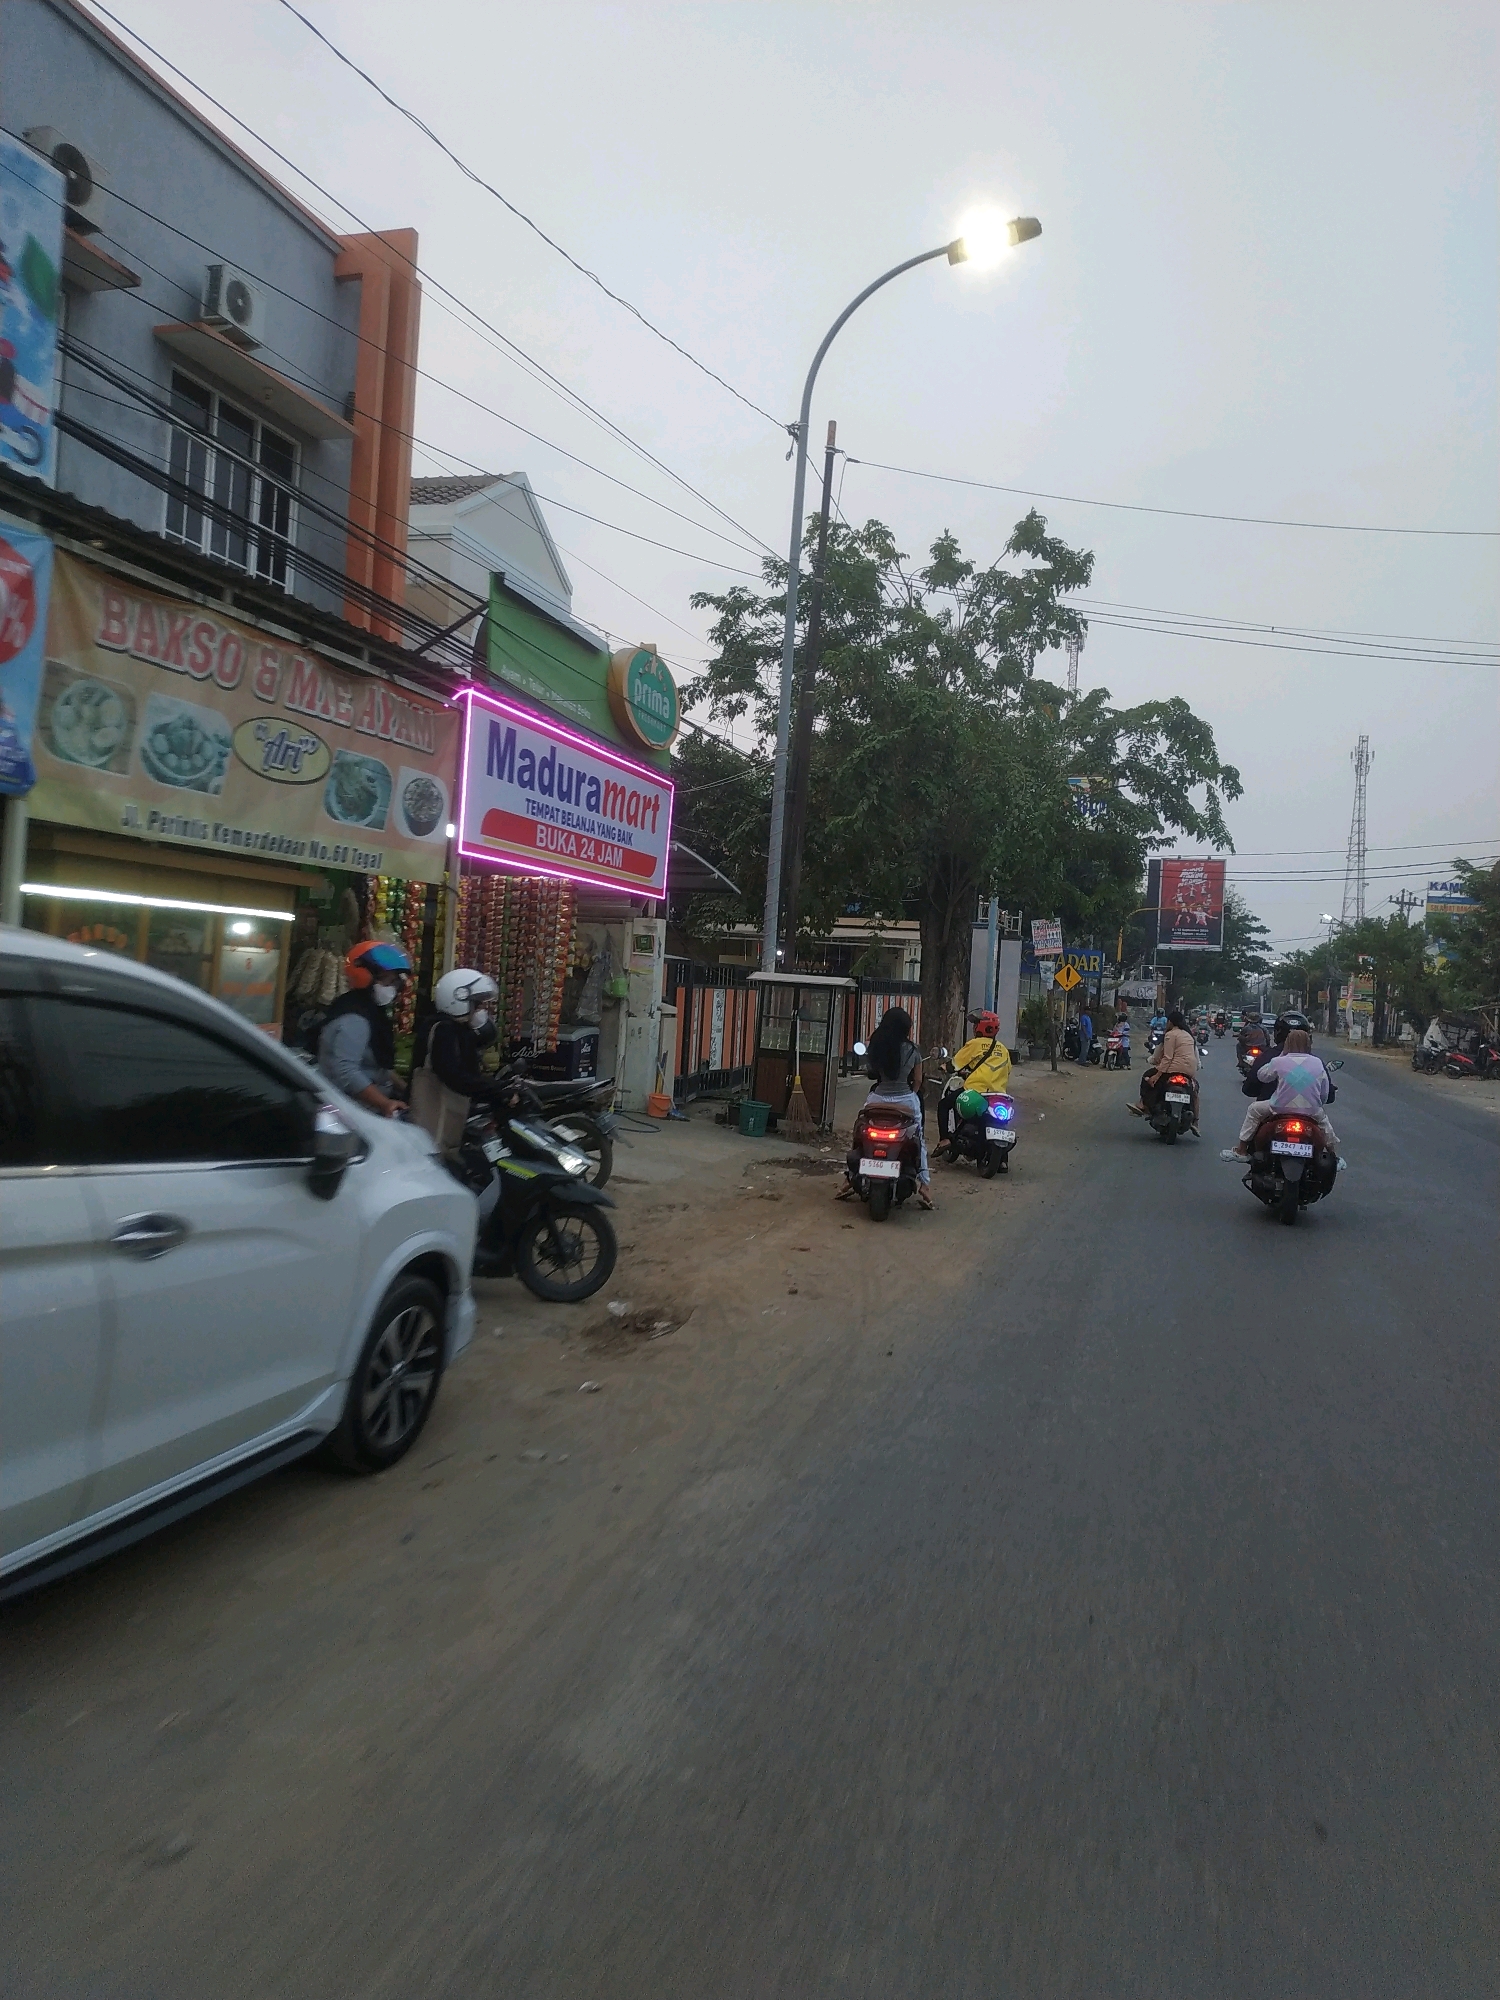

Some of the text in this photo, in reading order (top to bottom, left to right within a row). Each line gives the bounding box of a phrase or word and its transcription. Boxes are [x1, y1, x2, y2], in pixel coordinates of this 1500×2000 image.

[97, 586, 246, 688] BAKSO
[254, 645, 283, 704] &
[634, 678, 670, 719] prima
[487, 719, 661, 835] Maduramart
[525, 798, 634, 846] TEMPAT BELANJA YANG BAIK
[351, 847, 383, 869] Tegal
[536, 824, 624, 868] BUKA 24 JAM
[1430, 881, 1464, 891] KAM
